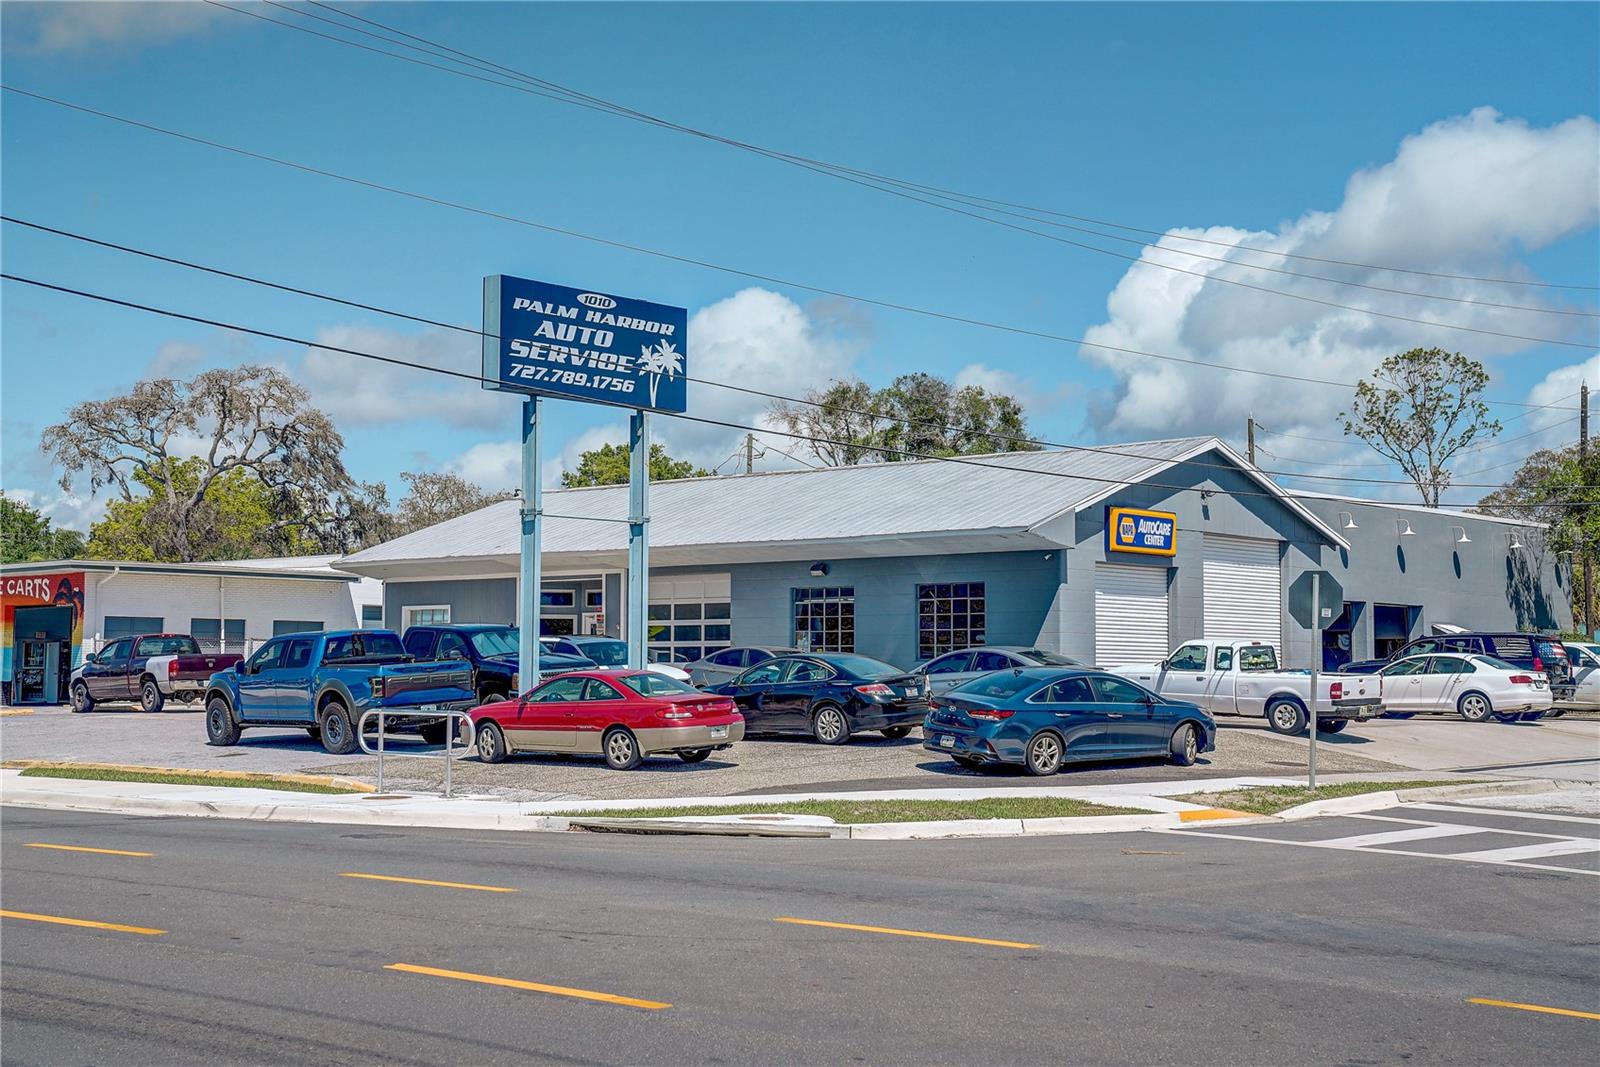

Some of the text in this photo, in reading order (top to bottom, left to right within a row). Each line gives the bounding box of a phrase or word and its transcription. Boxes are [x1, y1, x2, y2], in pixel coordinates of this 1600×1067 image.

[584, 295, 611, 308] 1010
[513, 297, 675, 336] PALM HARBOR
[533, 320, 614, 348] AUTO
[509, 338, 636, 374] SERVICE
[509, 363, 636, 393] 727.789.1756
[1144, 534, 1164, 546] CENTER
[7, 578, 50, 602] CARTS
